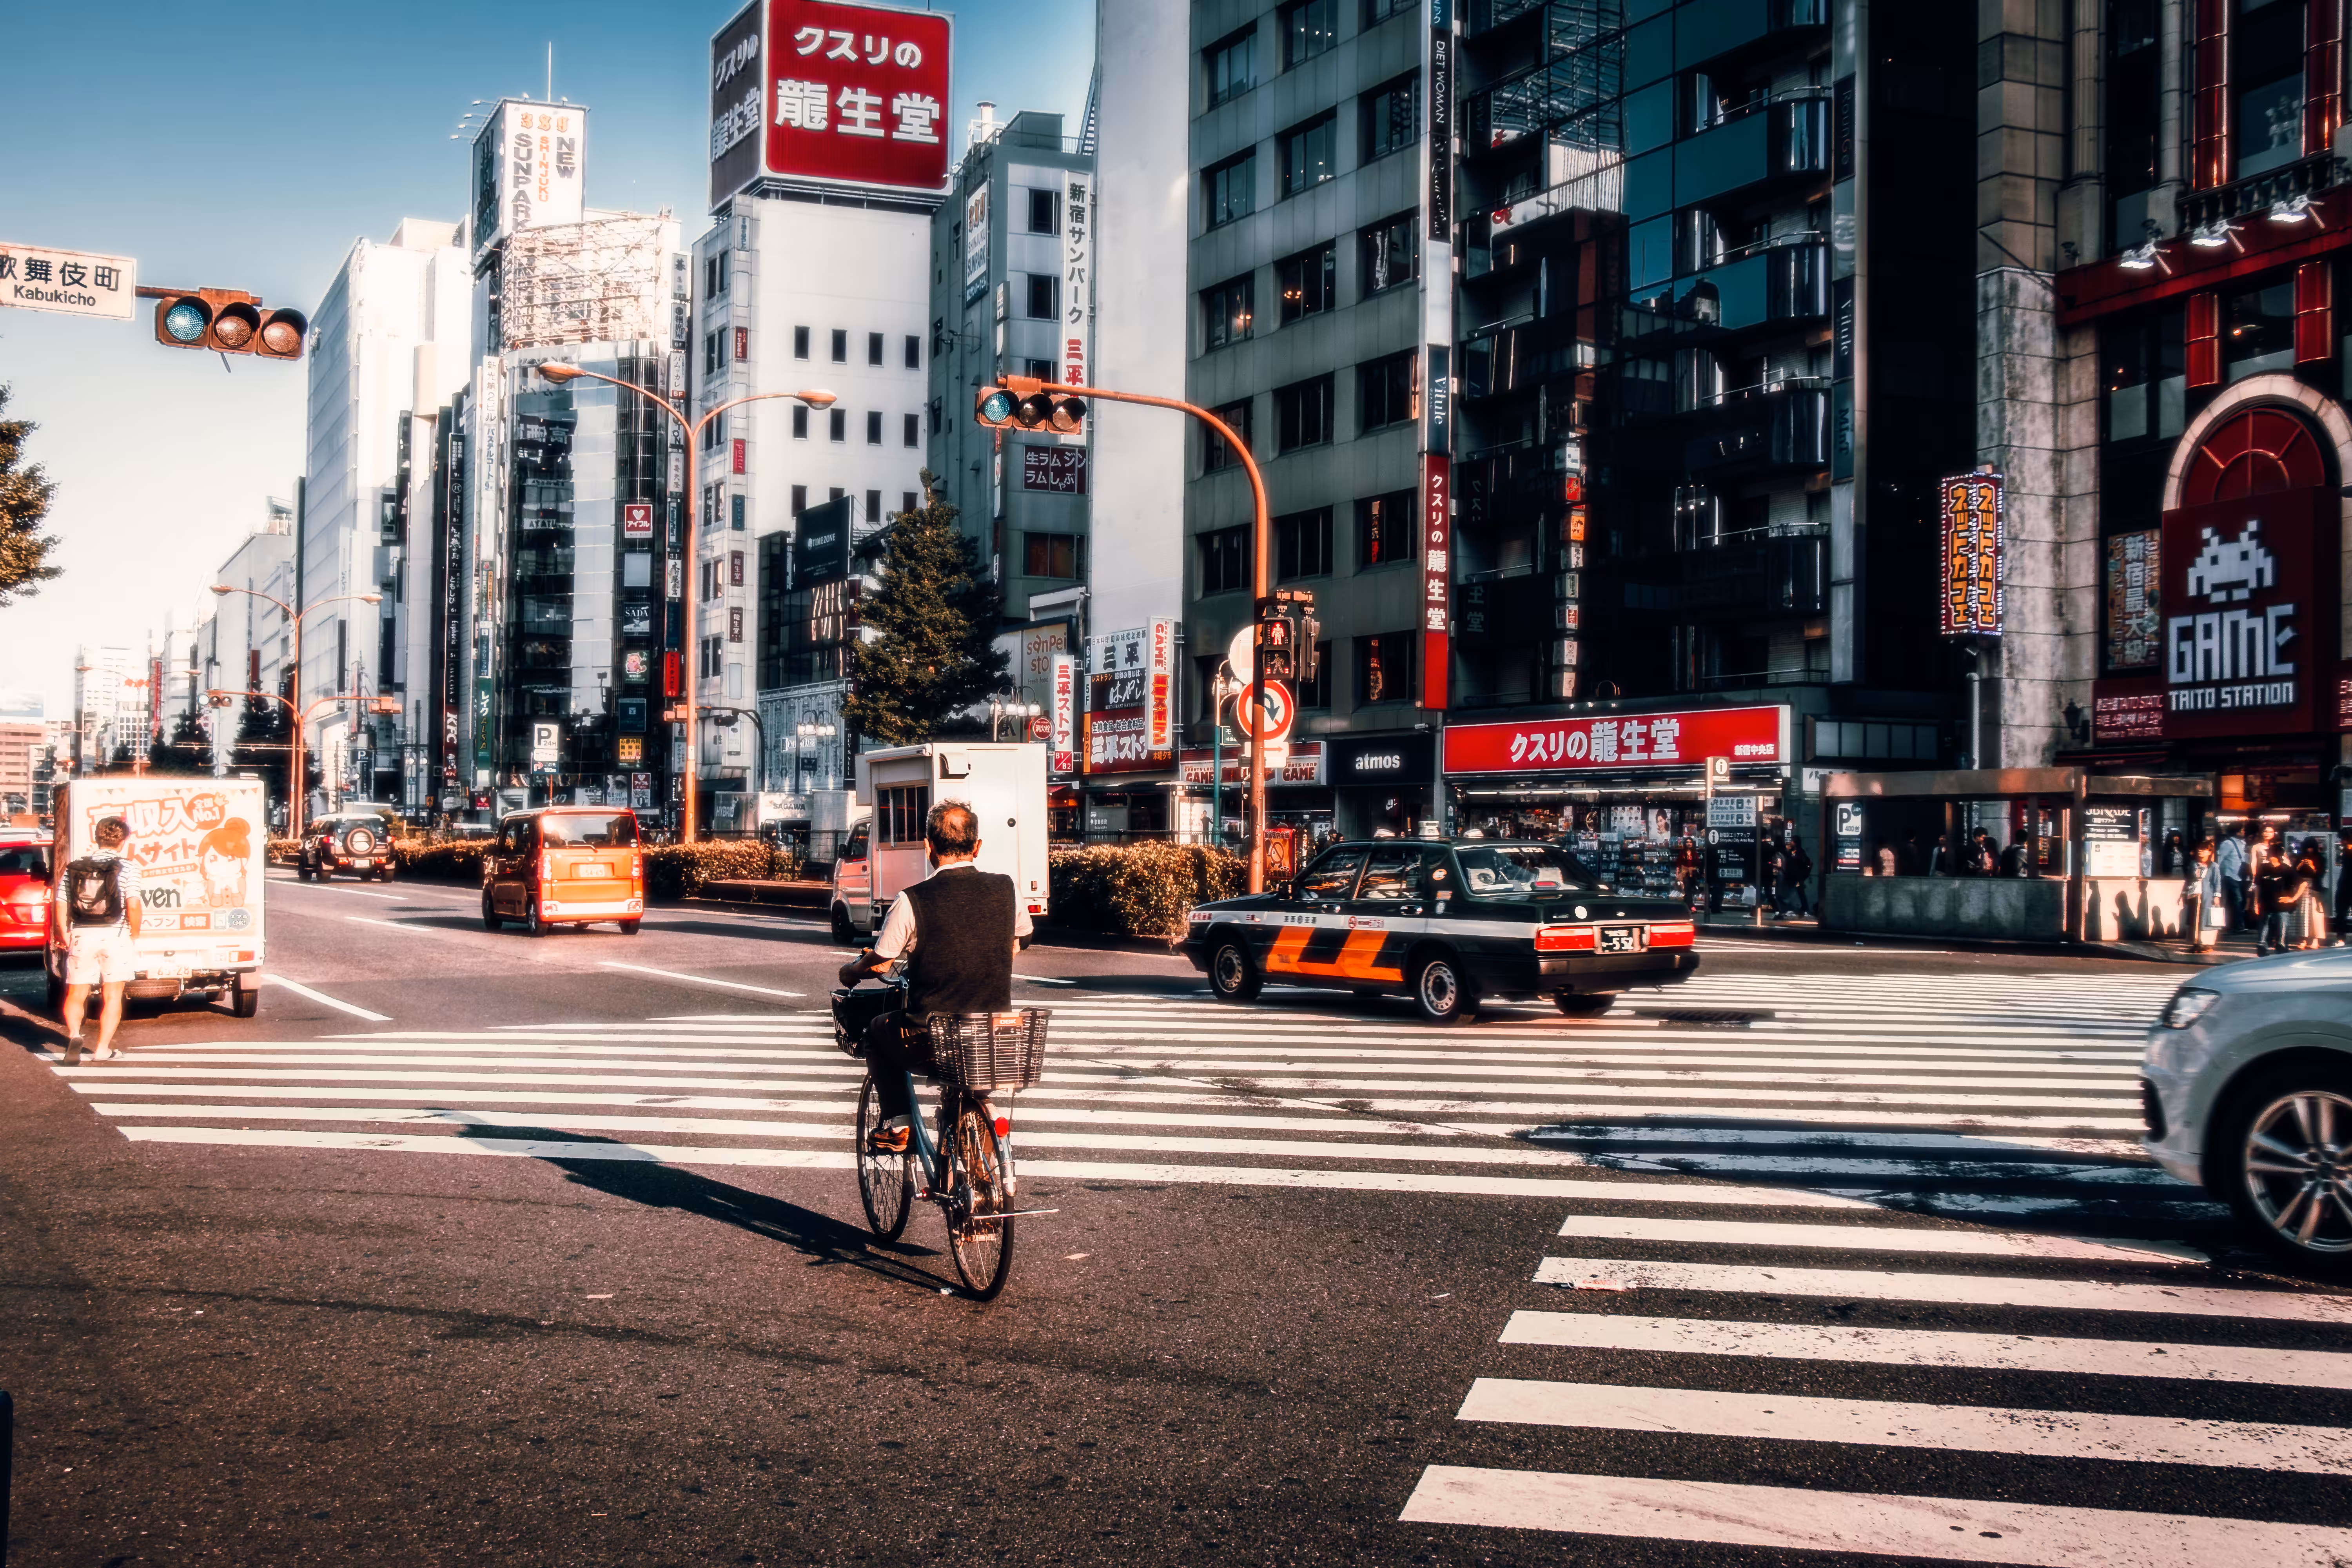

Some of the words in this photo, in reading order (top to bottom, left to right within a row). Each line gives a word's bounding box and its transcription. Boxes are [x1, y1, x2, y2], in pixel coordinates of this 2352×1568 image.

[715, 34, 759, 91] クスリの
[794, 26, 922, 69] クスリの
[1436, 40, 1445, 69] DIET
[774, 79, 939, 145] 龍生堂
[1436, 71, 1445, 124] WOMAN
[539, 136, 549, 202] SHINJUKU
[556, 136, 577, 179] NEW
[511, 133, 533, 232] SUNPARK
[967, 244, 986, 278] SUNPARK
[1068, 181, 1087, 326] 新宿サンパーク
[0, 254, 122, 292] 歌舞伎町
[14, 284, 96, 307] Kabukicho
[1065, 338, 1084, 386] 三平
[1434, 376, 1446, 425] Vitule
[1026, 451, 1086, 468] 生ラムジン
[1026, 470, 1075, 490] ラムしゃぶ
[812, 533, 835, 547] TIMEZONE
[1427, 475, 1446, 630] クスリの龍生堂
[1977, 485, 1995, 623] ネットカフェ
[1951, 487, 1969, 624] ネットカフェ
[1092, 636, 1109, 646] 日本料理
[1102, 641, 1140, 671] 三平
[1155, 622, 1164, 668] GAME
[2167, 603, 2299, 684] GAME
[1085, 646, 1091, 668] 6F
[1092, 674, 1112, 682] レストラン
[480, 690, 490, 717] レイク
[1057, 664, 1071, 744] 三平ストア
[1085, 683, 1090, 706] 5F
[2169, 686, 2215, 711] TAITO
[2221, 680, 2294, 708] STATION
[446, 711, 458, 745] KFC
[480, 717, 488, 750] ALSA
[537, 727, 552, 746] P
[1035, 724, 1051, 733] 消火栓
[1085, 731, 1089, 753] B2
[1510, 717, 1680, 764] クスリの龍生堂
[1355, 753, 1401, 770] atmos
[1734, 744, 1775, 756] 新宿中央店
[1186, 771, 1214, 784] GAME
[1282, 767, 1315, 782] GAME
[544, 794, 567, 803] レイク
[716, 806, 734, 817] HYBRID
[192, 806, 220, 822] No.1
[1839, 808, 1852, 832] P
